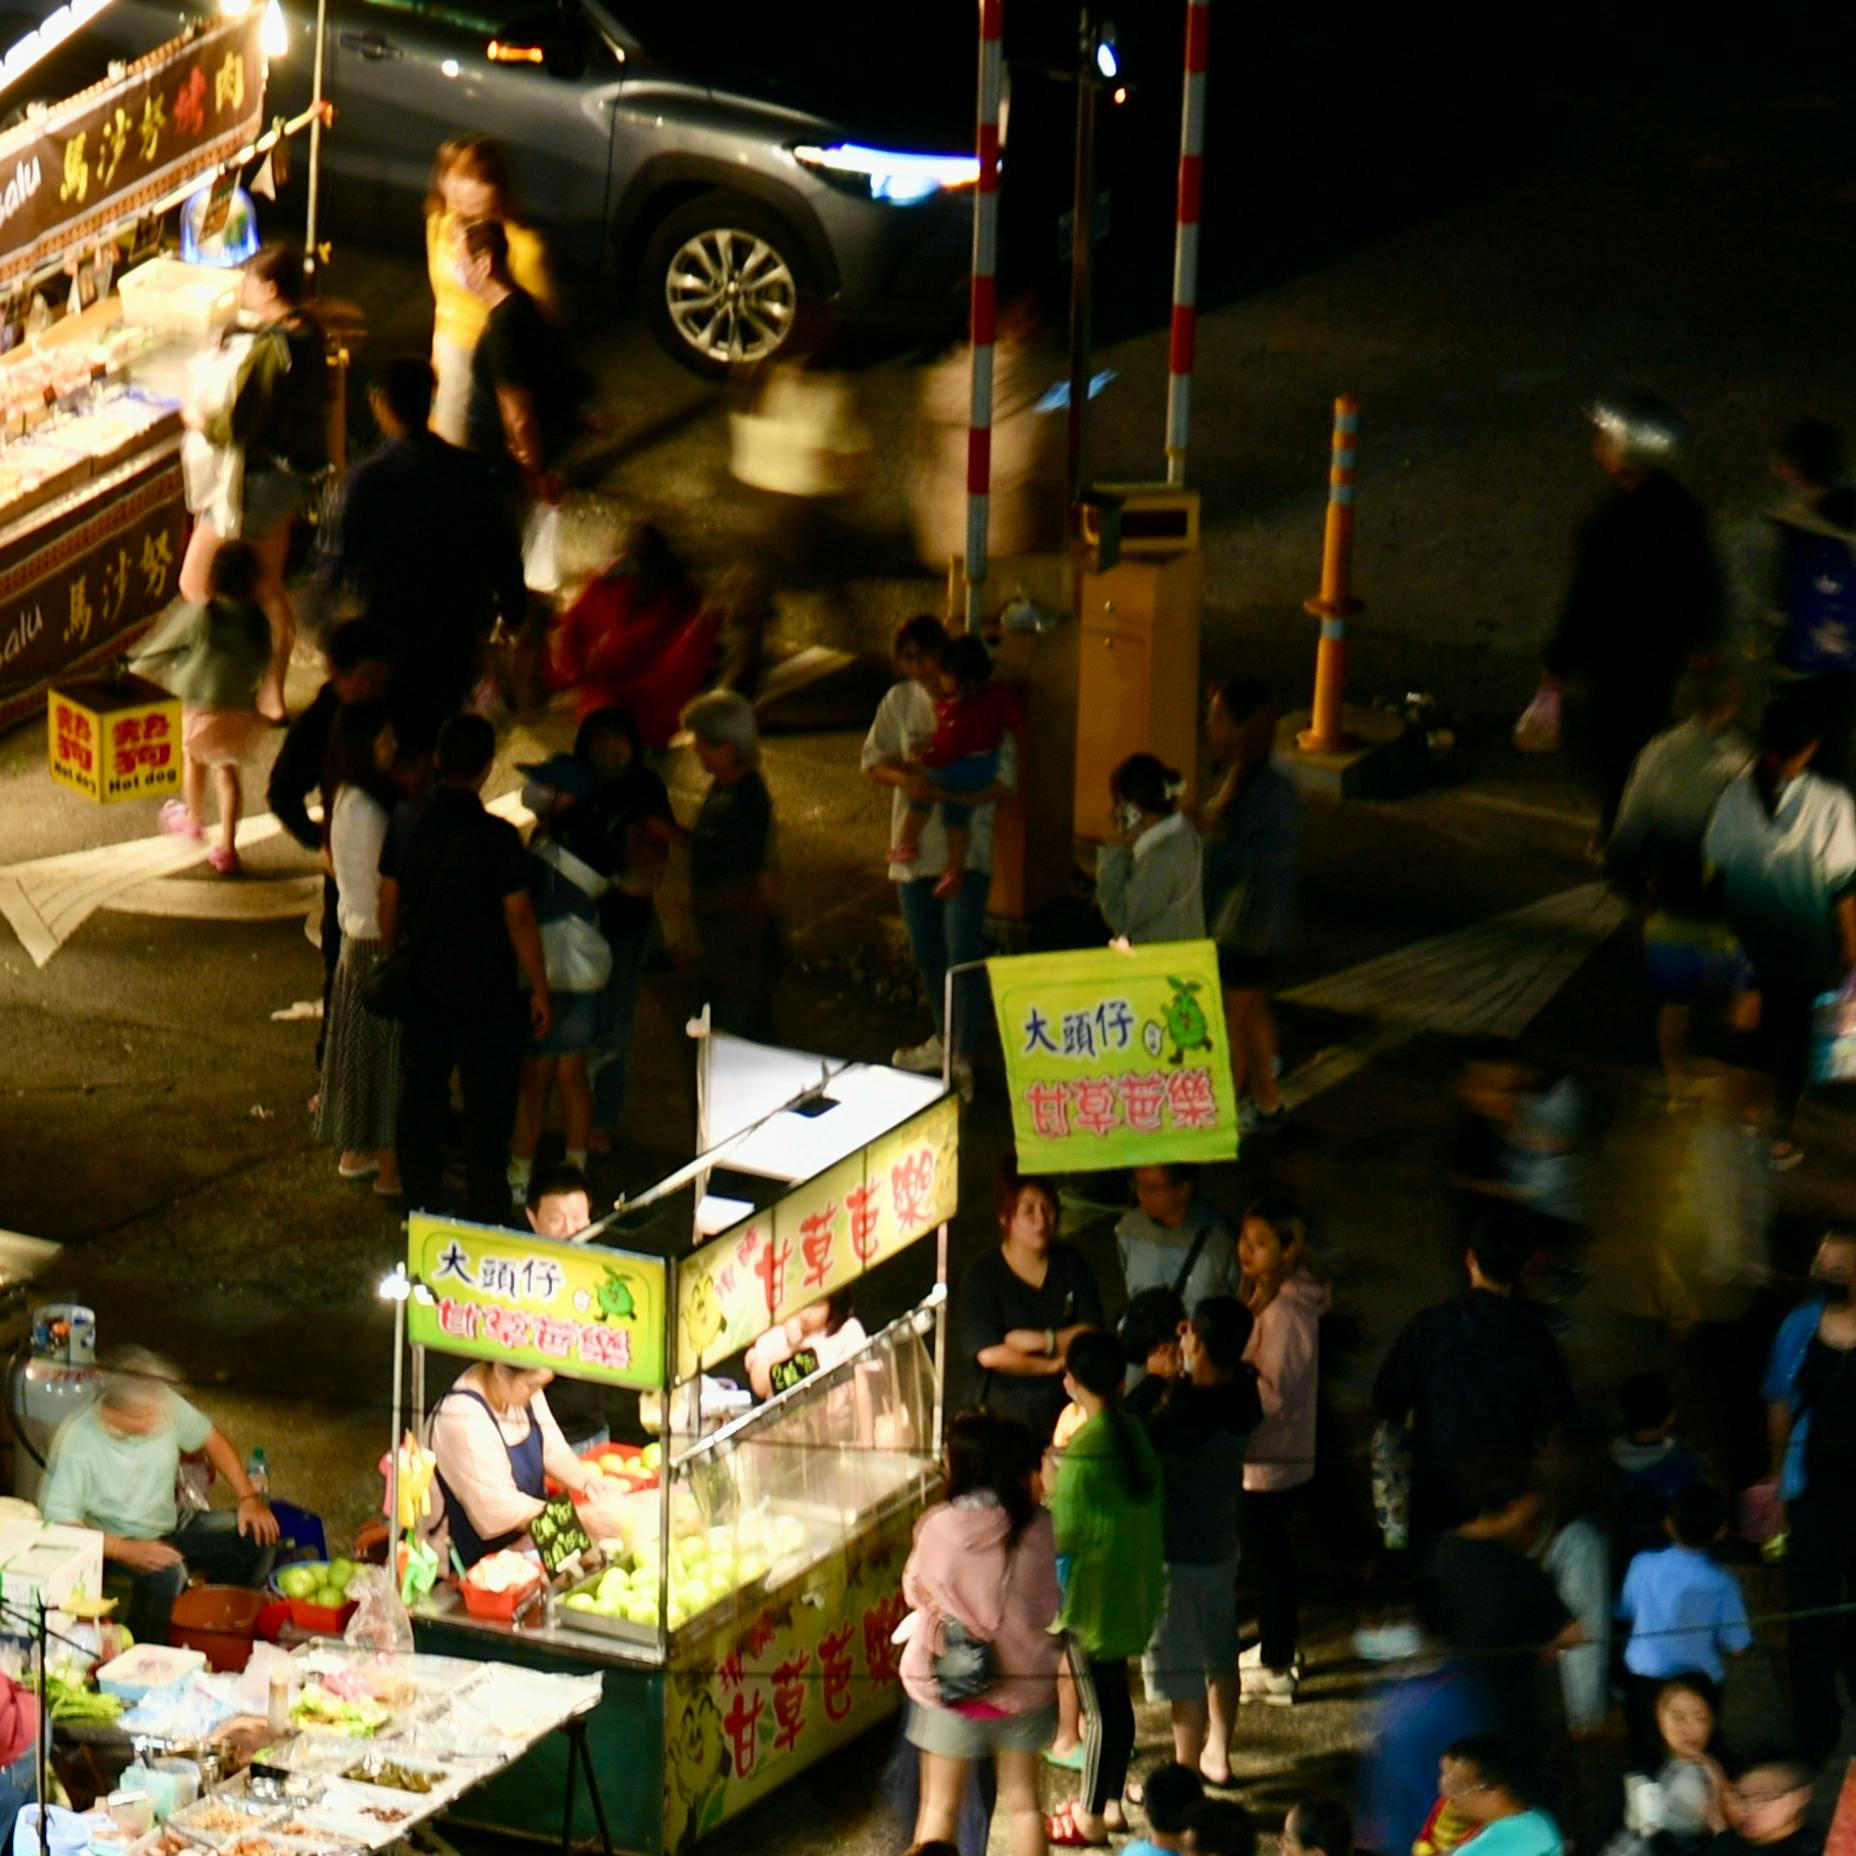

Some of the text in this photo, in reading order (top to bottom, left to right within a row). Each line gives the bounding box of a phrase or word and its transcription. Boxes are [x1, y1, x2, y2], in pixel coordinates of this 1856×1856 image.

[108, 766, 178, 794] Hot dog
[1023, 1001, 1134, 1058] 大頭仔
[1027, 1067, 1218, 1139] 甘草芭樂
[754, 1148, 934, 1315] 甘草芭樂
[435, 1243, 561, 1298] 大頭仔
